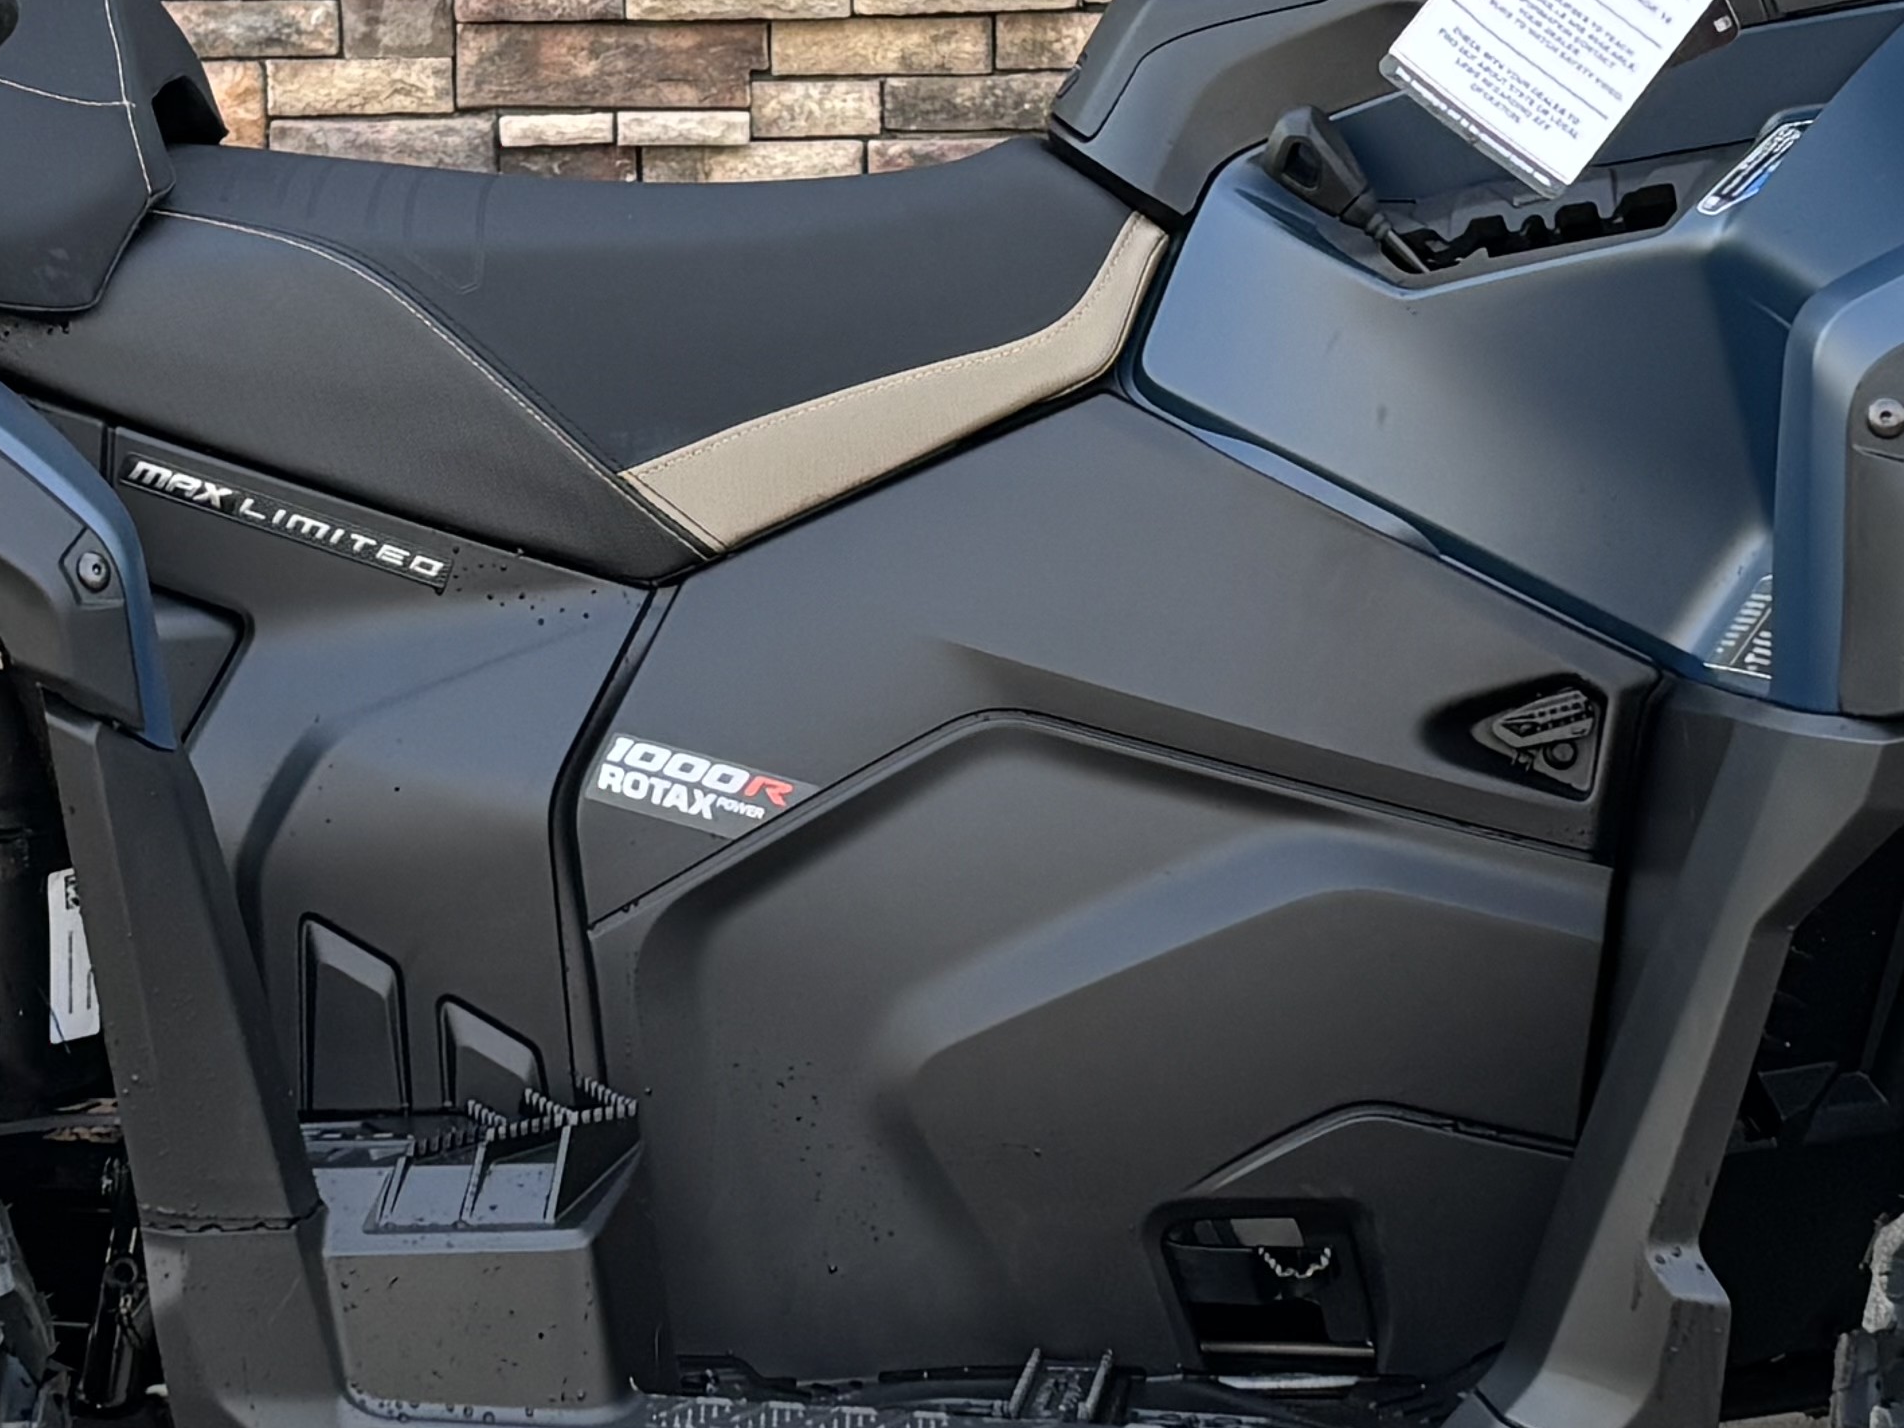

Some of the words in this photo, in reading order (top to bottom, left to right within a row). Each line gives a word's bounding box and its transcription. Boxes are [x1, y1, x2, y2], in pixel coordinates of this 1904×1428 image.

[128, 460, 234, 509] MAX
[238, 497, 445, 578] LIMITED
[597, 762, 719, 820] ROTAX
[715, 796, 765, 820] POWER
[605, 736, 794, 809] 1000R
